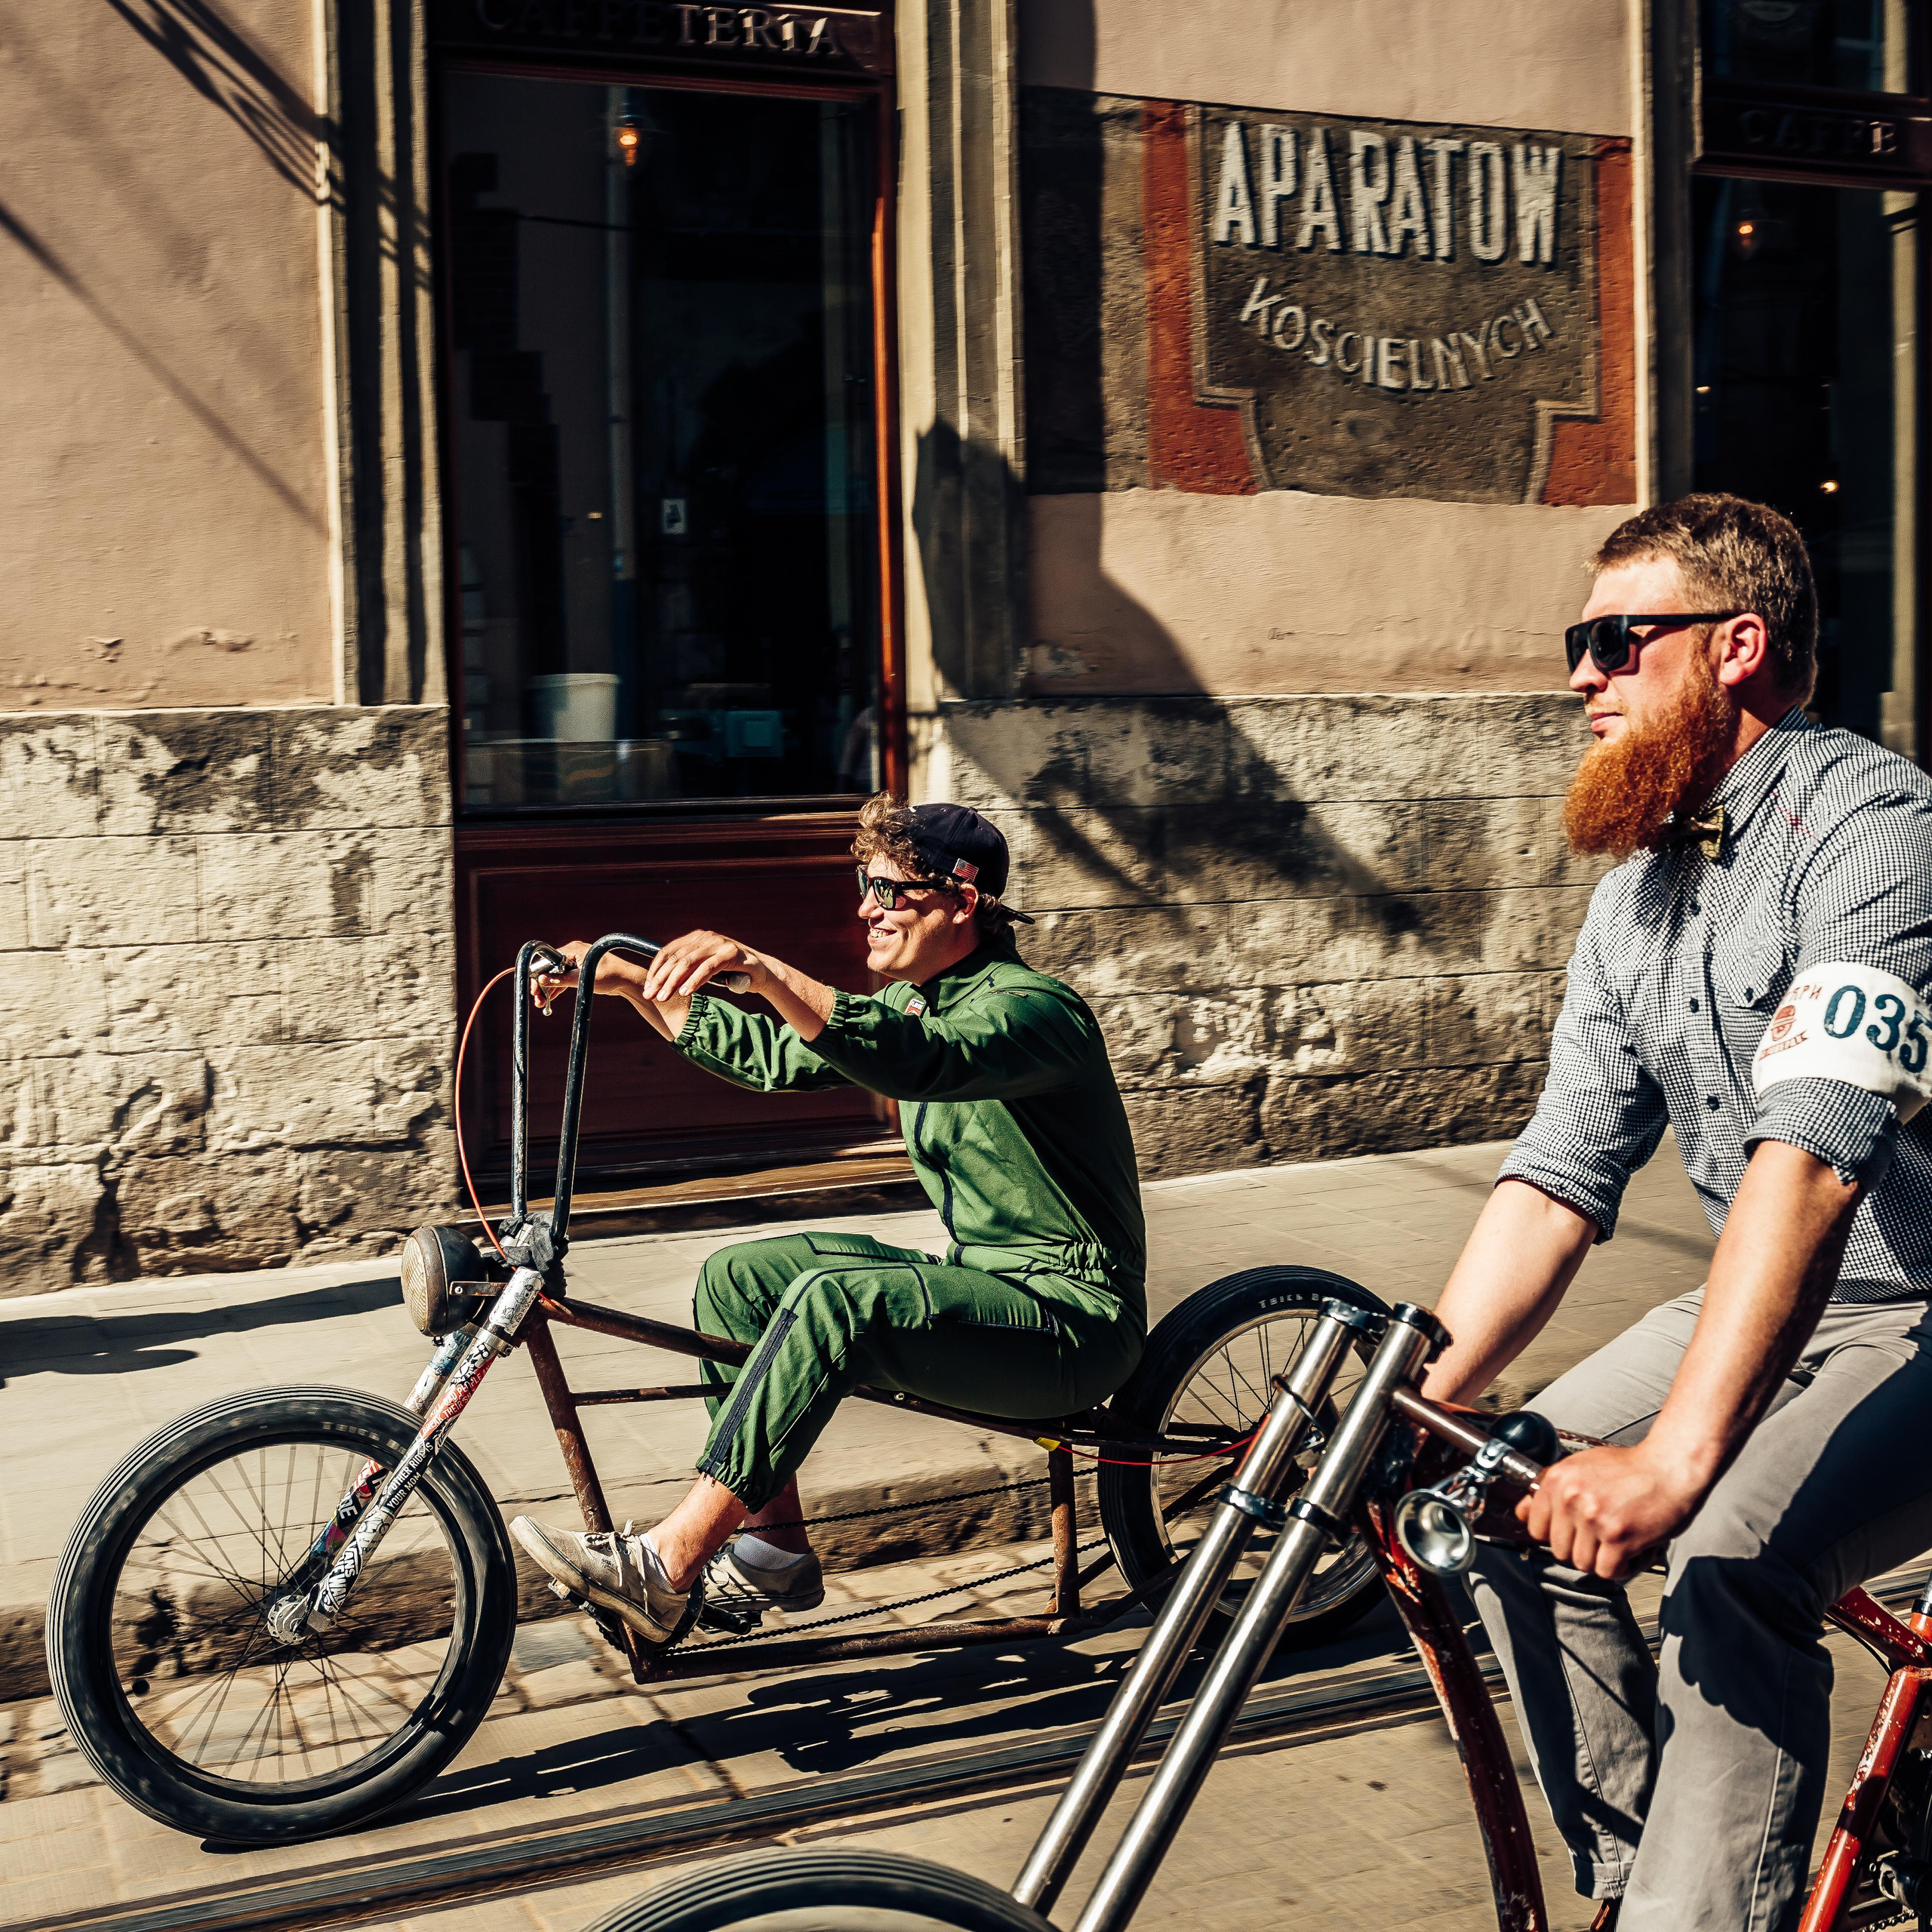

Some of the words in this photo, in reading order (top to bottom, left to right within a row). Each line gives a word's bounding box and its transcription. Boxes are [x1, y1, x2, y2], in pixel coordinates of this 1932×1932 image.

[478, 0, 844, 55] CAFFETERIA
[1214, 121, 1564, 264] APARATOW
[443, 1400, 463, 1419] THEIR
[386, 1489, 408, 1509] YOUR
[404, 1472, 422, 1491] MOM
[392, 1467, 413, 1491] OTHER
